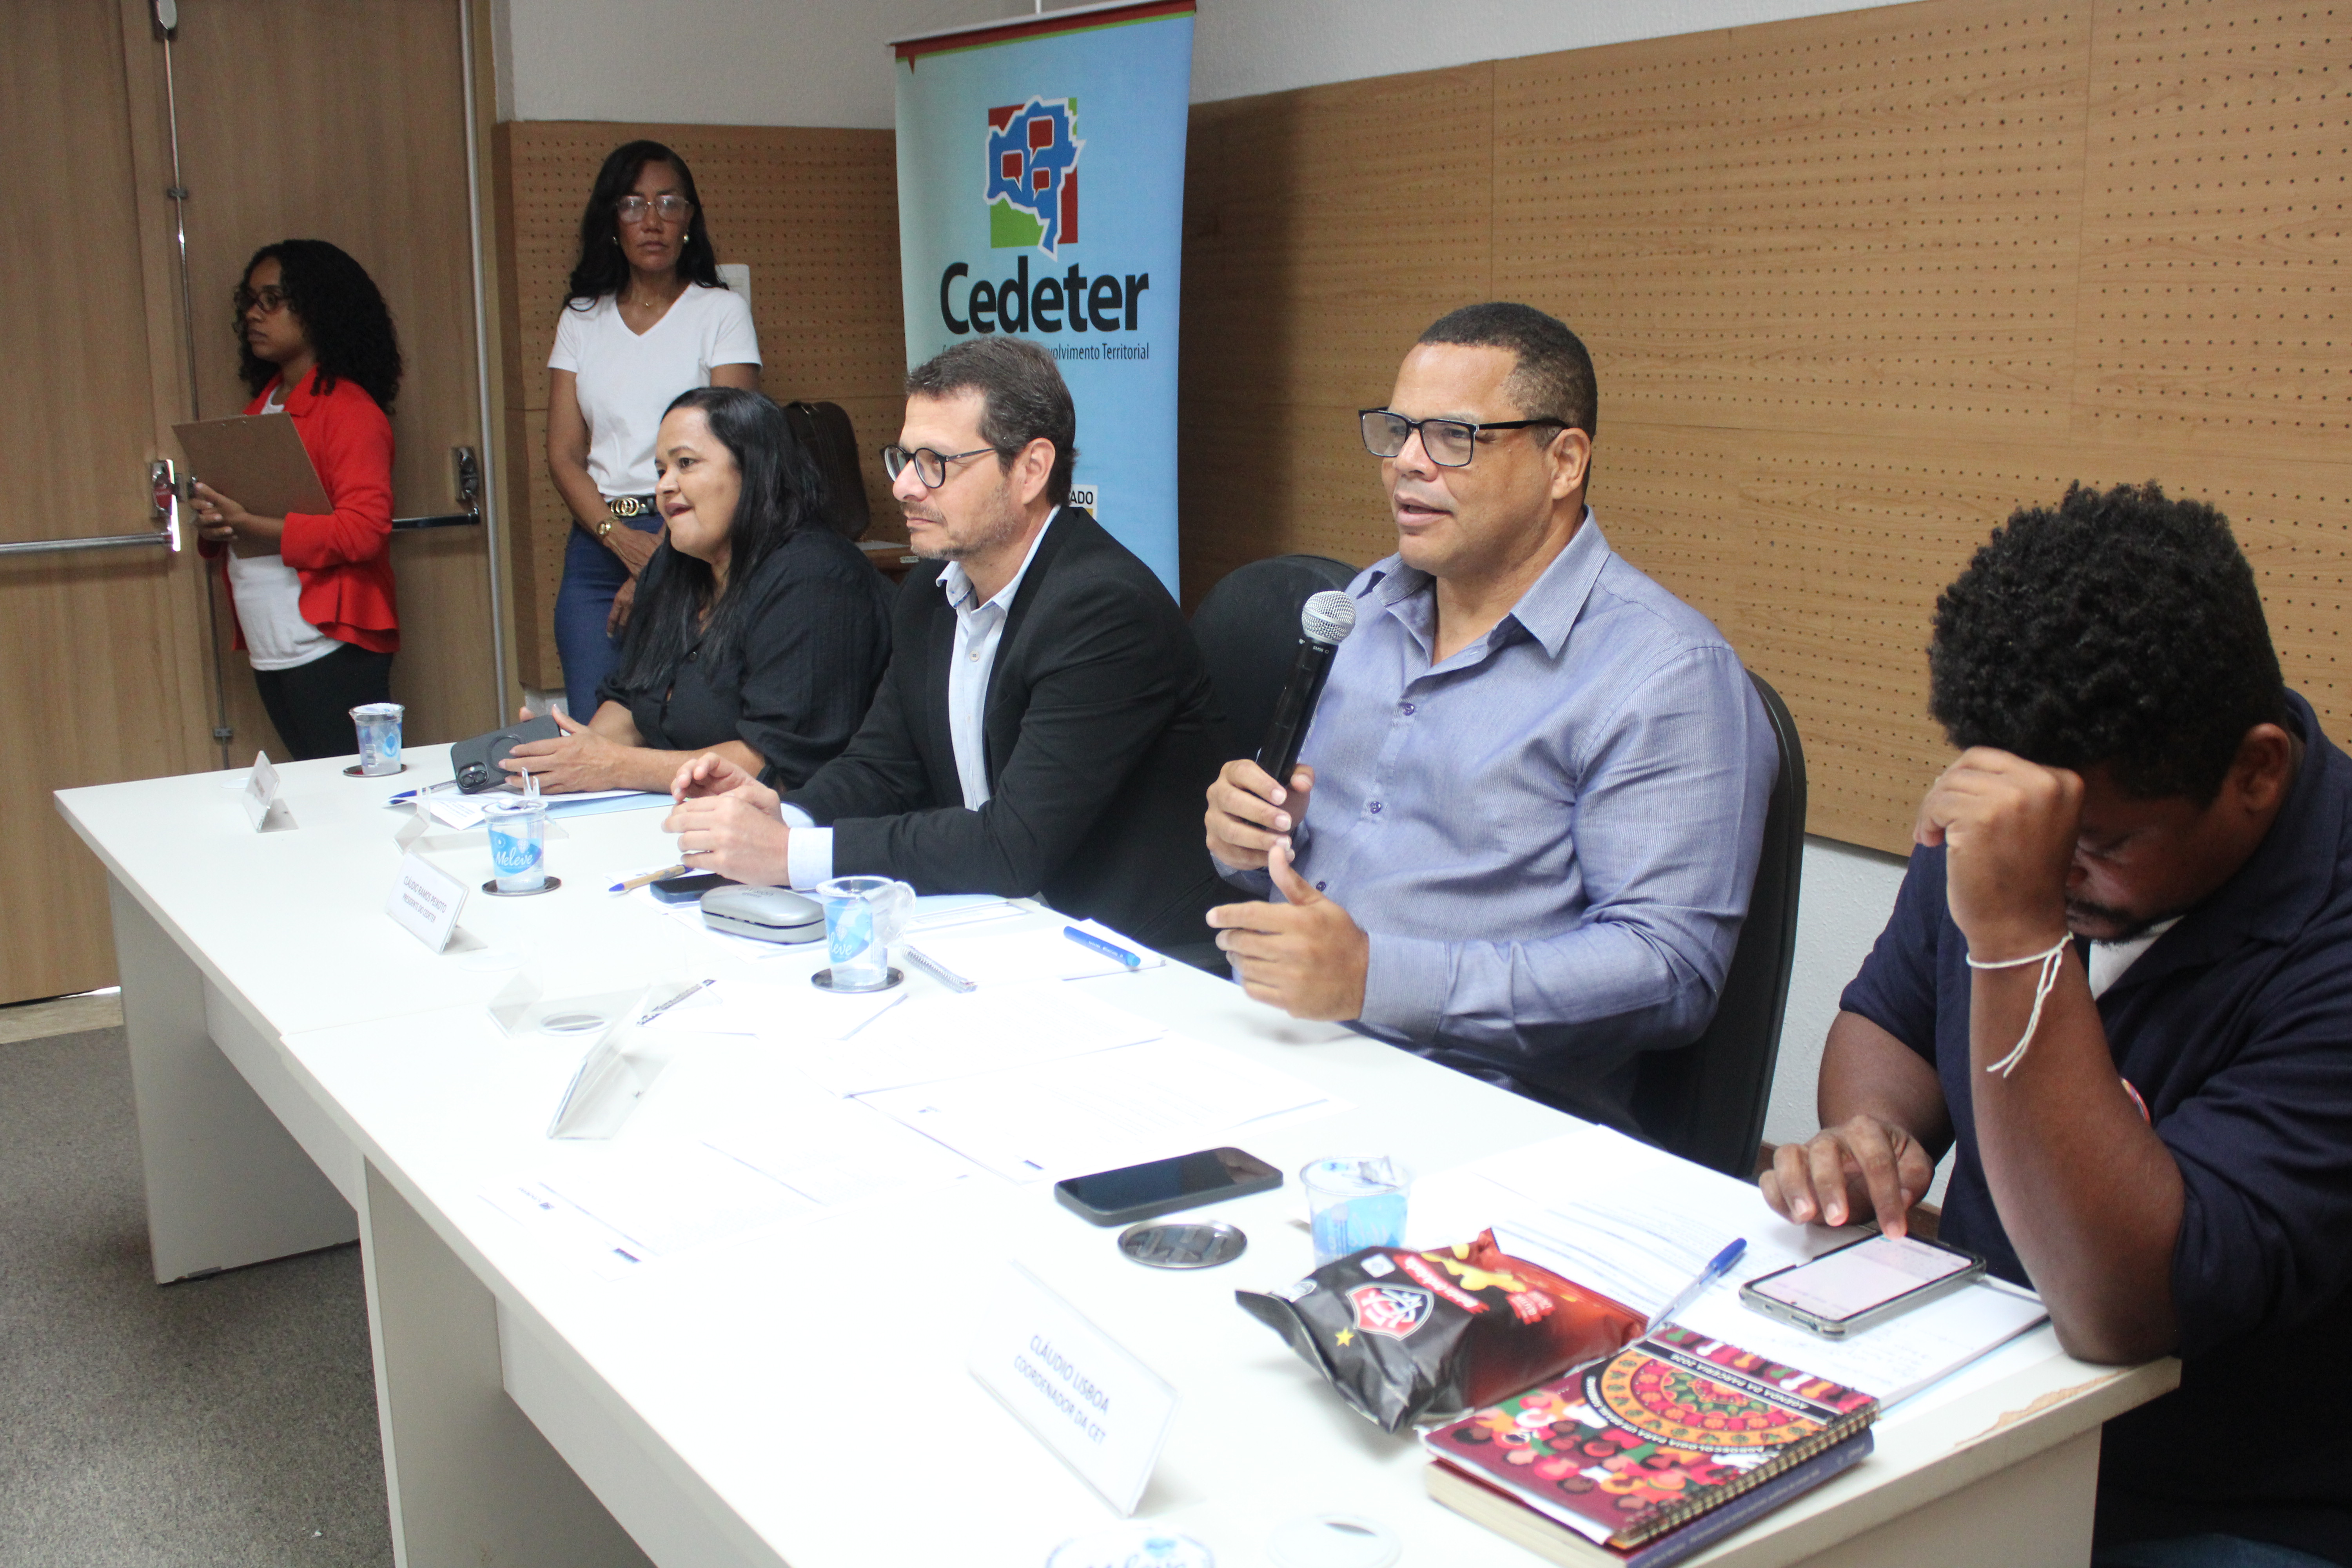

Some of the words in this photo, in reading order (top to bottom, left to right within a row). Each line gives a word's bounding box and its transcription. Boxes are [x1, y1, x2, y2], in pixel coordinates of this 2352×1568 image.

[940, 255, 1149, 334] Cedeter
[1047, 343, 1100, 360] volvimento
[1102, 342, 1149, 360] Territorial
[1071, 490, 1093, 505] ADO
[495, 847, 533, 867] Meleve
[403, 875, 419, 893] CLÁUDIO
[417, 886, 432, 902] RAMOS
[430, 895, 447, 913] PEIXOTO
[402, 893, 419, 911] PRESIDENTE
[417, 905, 424, 914] DO
[422, 908, 436, 923] CEDETER
[828, 931, 853, 955] leve
[1670, 1353, 1697, 1367] 2026
[1030, 1335, 1074, 1381] CLÁUDIO
[1073, 1372, 1110, 1416] LISBOA
[1696, 1363, 1747, 1387] PARCERIA
[1746, 1382, 1764, 1393] DA
[1014, 1355, 1075, 1419] COORDENADOR
[1074, 1410, 1088, 1431] DA
[1087, 1423, 1106, 1445] CET
[1764, 1389, 1809, 1410] AGENDA
[1637, 1428, 1668, 1444] PARA
[1668, 1438, 1764, 1454] AGROECOLOGIA
